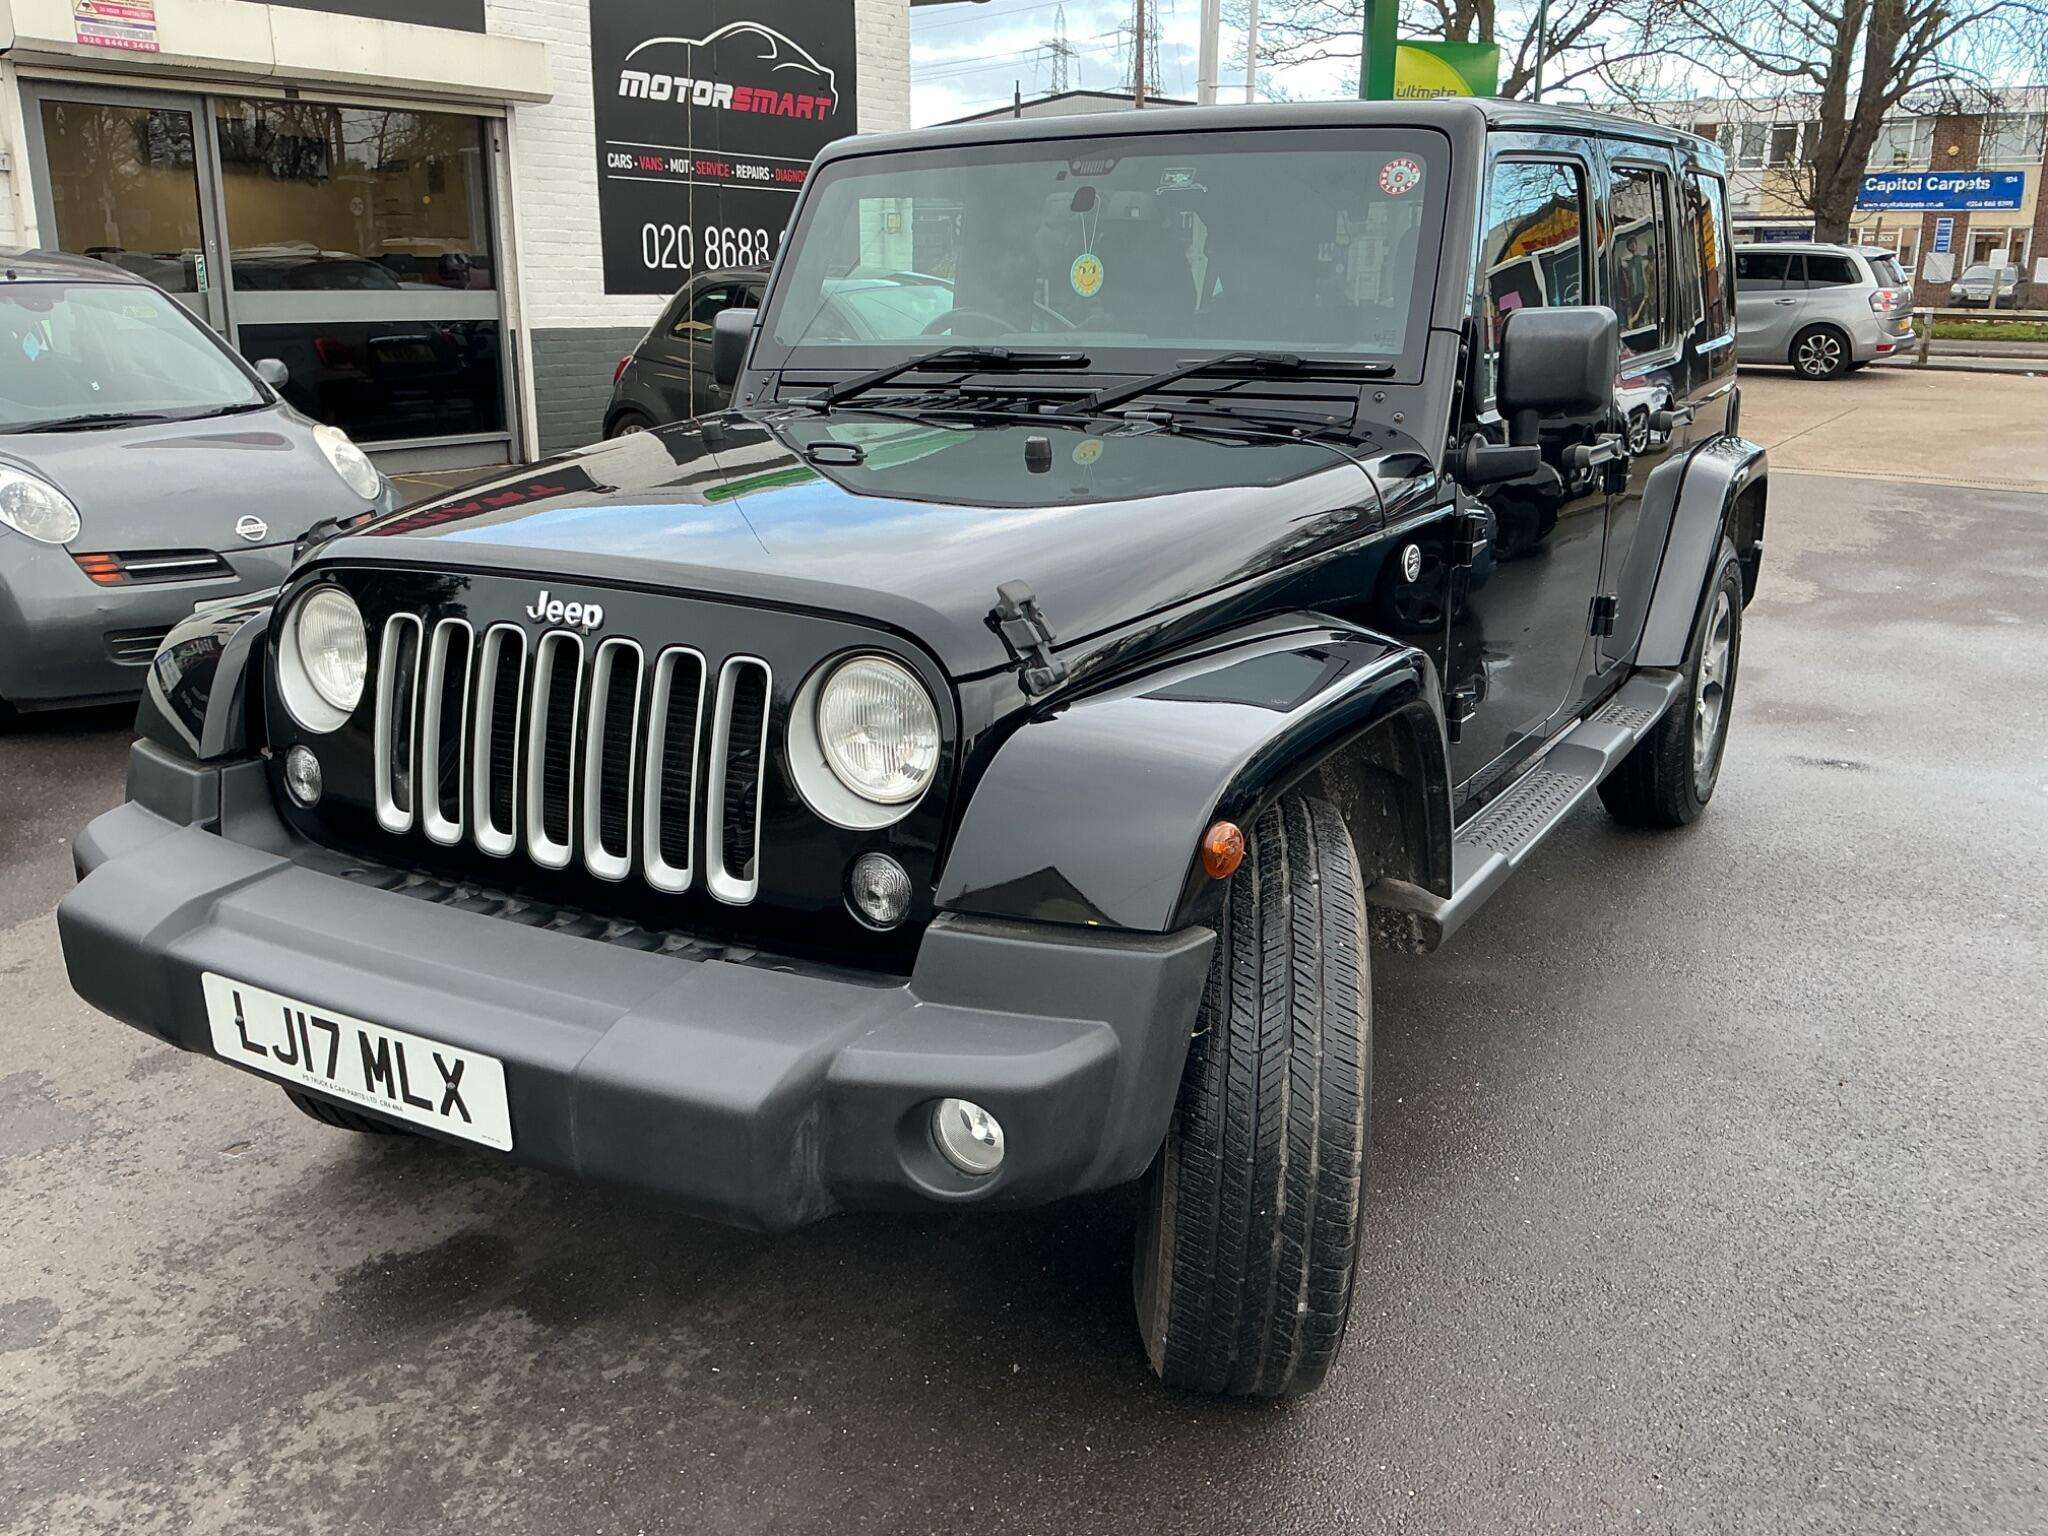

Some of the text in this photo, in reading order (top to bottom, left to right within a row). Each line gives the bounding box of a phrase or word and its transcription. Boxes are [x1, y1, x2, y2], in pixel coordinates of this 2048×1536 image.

[618, 69, 832, 121] MOTORSMART
[607, 153, 633, 169] CARS
[639, 155, 664, 172] VANS
[670, 157, 690, 174] MOT
[695, 160, 731, 178] SERVICE
[736, 165, 770, 181] REPAIRS
[1865, 177, 1991, 194] Capitol Carpets
[642, 223, 694, 269] 020
[526, 590, 604, 635] Jeep
[232, 990, 473, 1124] LJ17 MLX
[310, 1076, 328, 1088] TRUCK
[334, 1084, 346, 1093] CAR
[346, 1088, 366, 1100] PARTS
